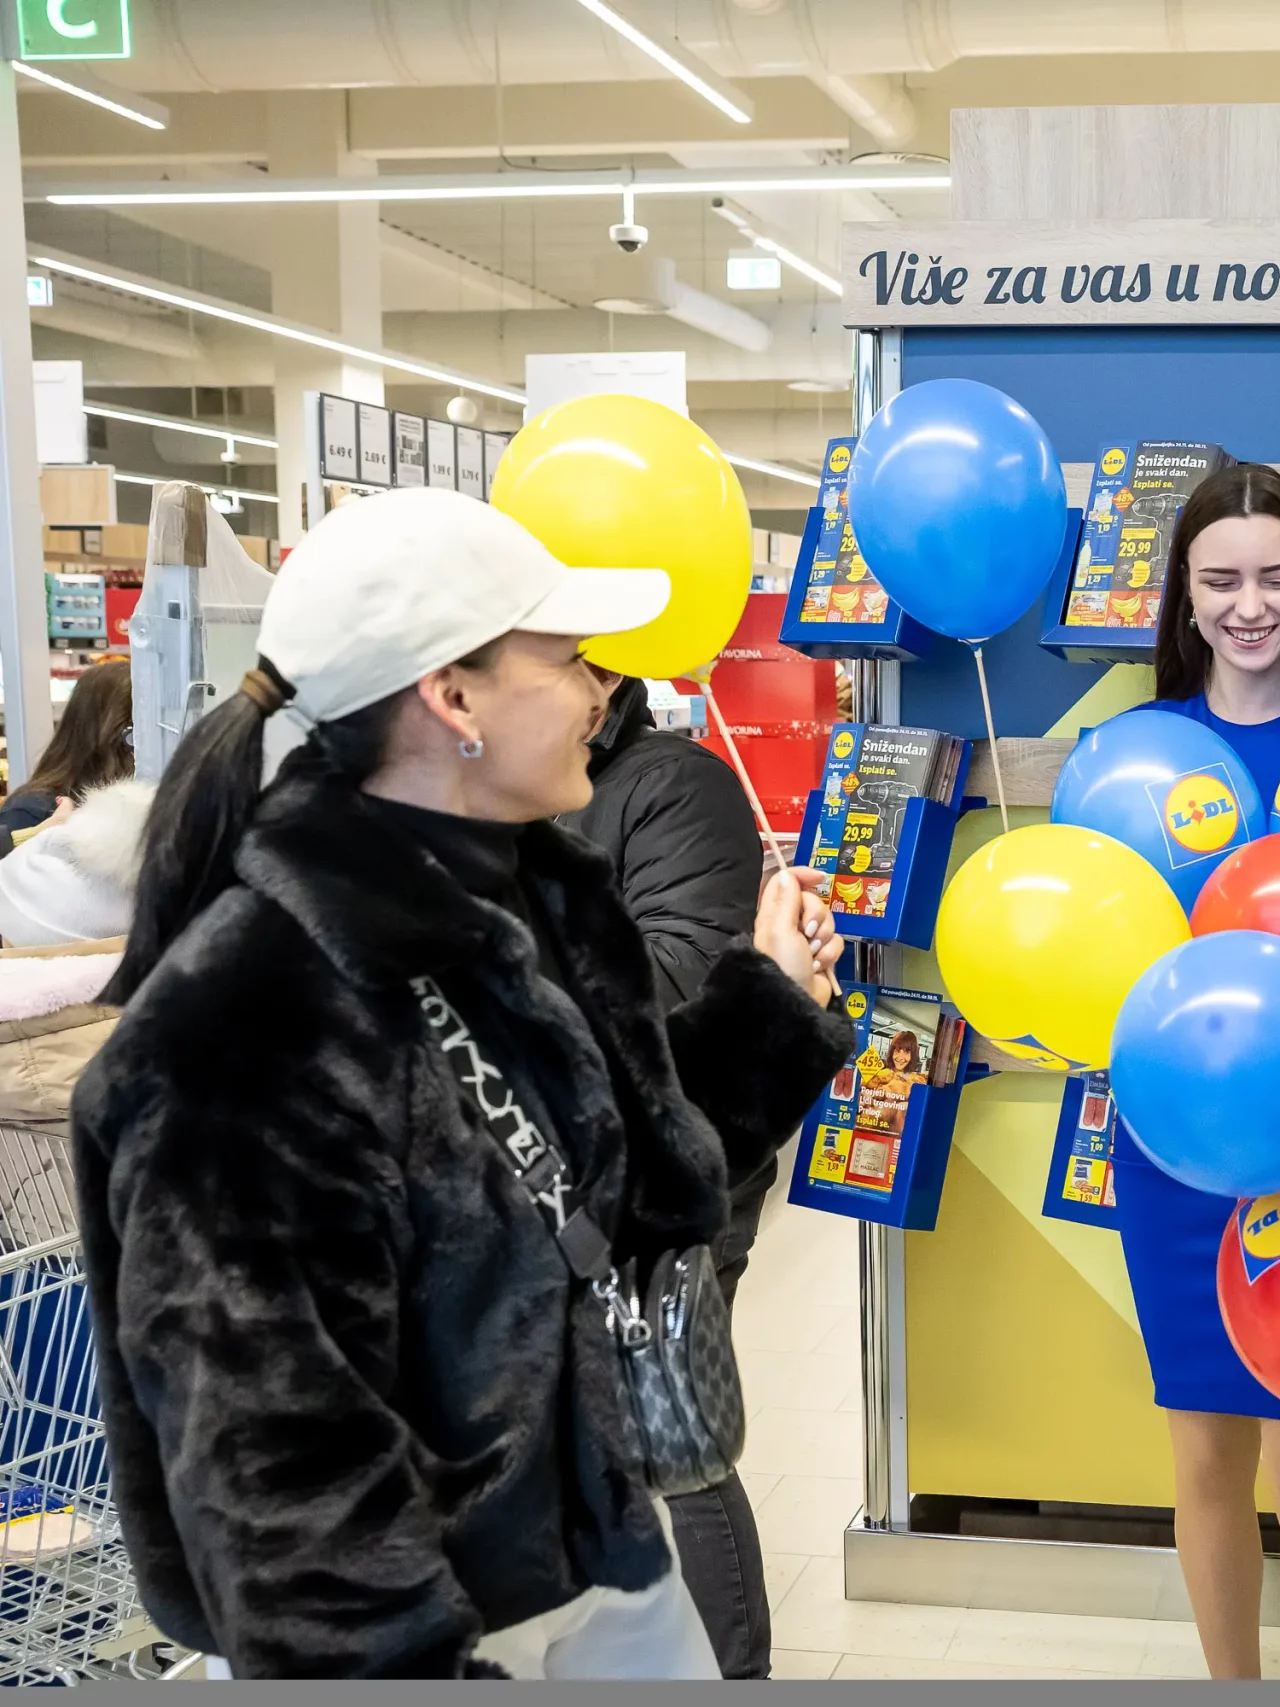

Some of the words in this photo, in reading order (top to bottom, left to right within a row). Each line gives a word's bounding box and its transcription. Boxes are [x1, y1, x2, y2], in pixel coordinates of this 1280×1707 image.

[859, 250, 968, 306] Više
[984, 267, 1048, 305] za
[1061, 263, 1152, 304] vas
[1166, 264, 1200, 302] u
[1136, 454, 1207, 468] Snižendan
[1134, 468, 1144, 478] je
[1145, 468, 1168, 476] svaki
[1169, 468, 1188, 477] dan.
[1133, 480, 1161, 490] Isplati
[1118, 542, 1151, 557] 29.99
[862, 739, 927, 756] Snižendan
[860, 753, 869, 762] je
[870, 754, 891, 763] svaki
[892, 756, 910, 764] dan.
[859, 765, 885, 775] Isplati
[843, 826, 873, 842] 29.99
[858, 1055, 882, 1068] -45%
